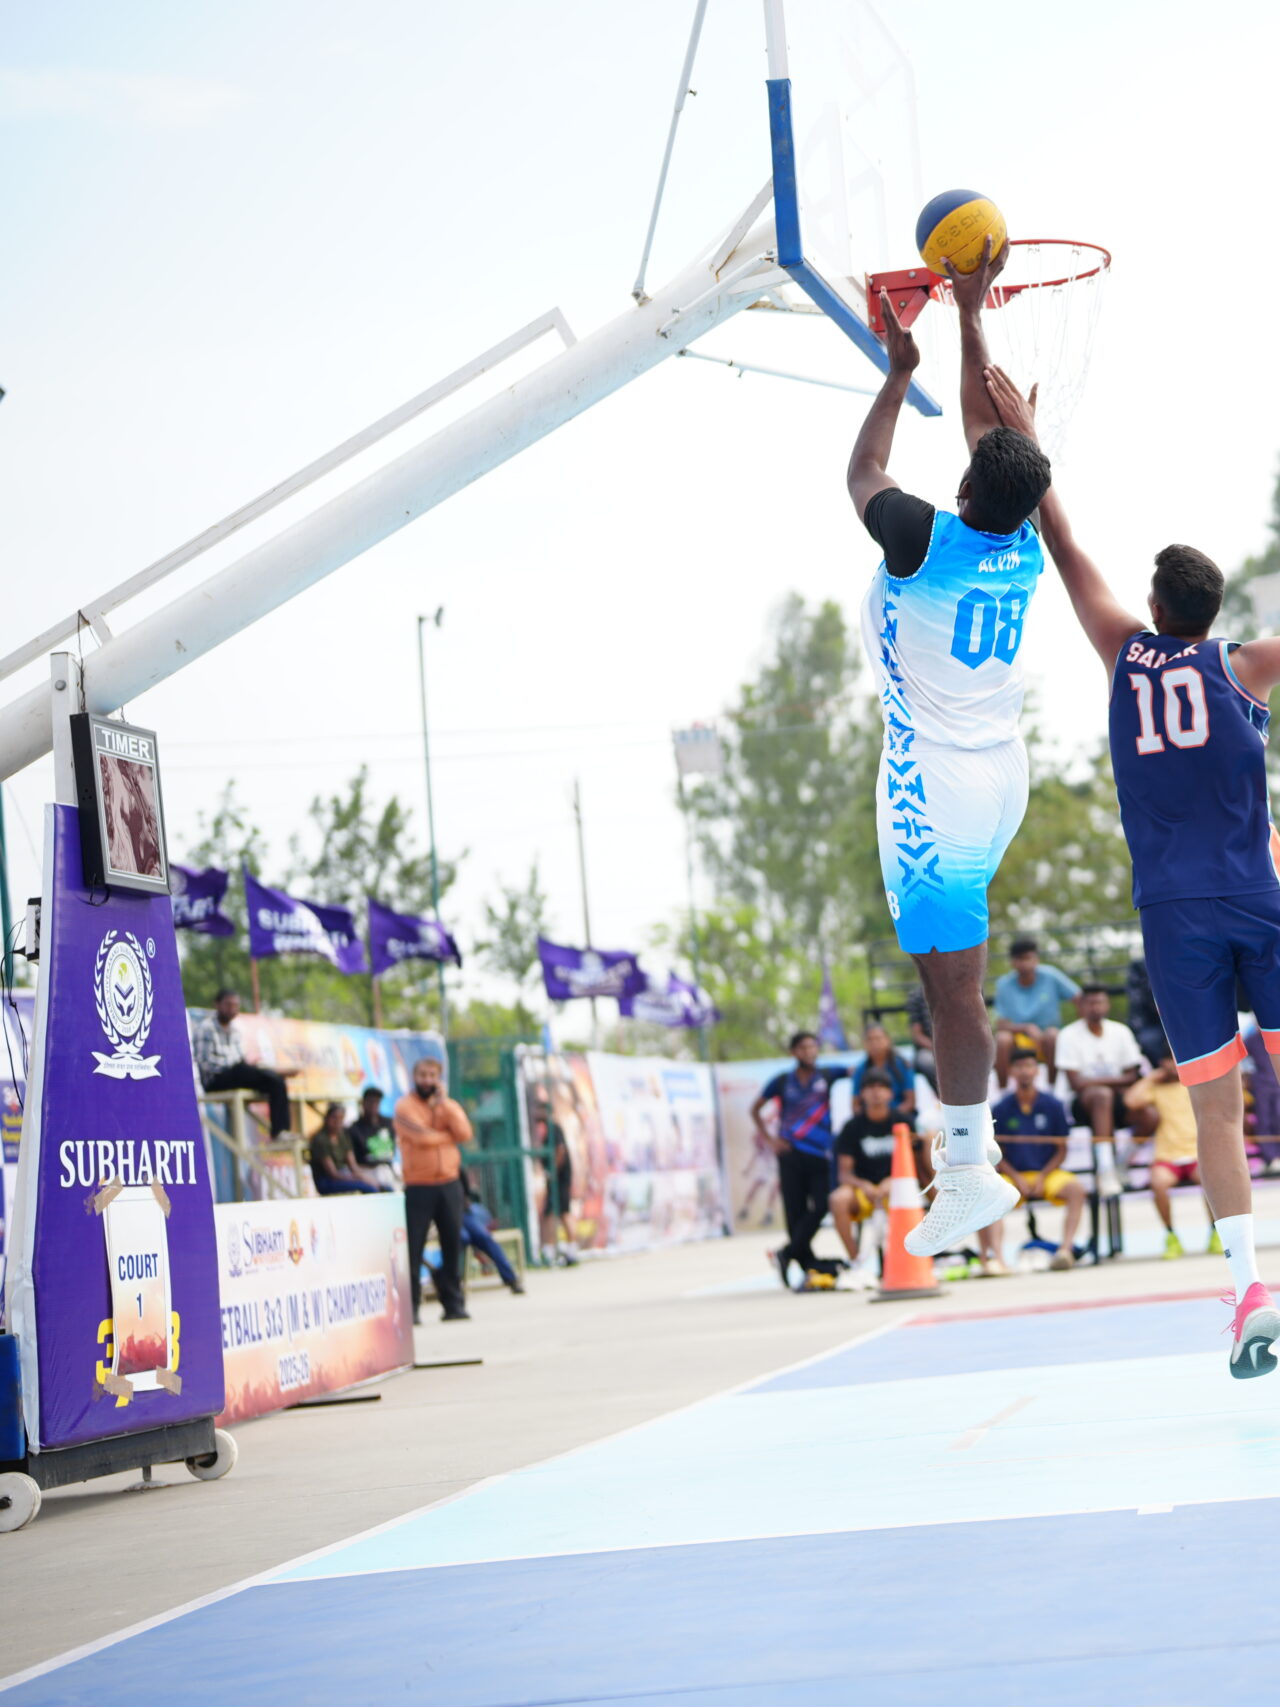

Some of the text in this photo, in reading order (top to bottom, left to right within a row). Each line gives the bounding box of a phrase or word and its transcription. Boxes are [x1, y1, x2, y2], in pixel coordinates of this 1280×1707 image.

[978, 549, 1020, 574] ALVIN
[950, 582, 1029, 670] 08
[1128, 665, 1210, 756] 10
[101, 729, 151, 759] TIMER
[60, 1140, 197, 1188] SUBHARTI
[118, 1253, 158, 1281] COURT
[136, 1292, 143, 1319] 1
[286, 1293, 301, 1343] (M
[303, 1291, 310, 1331] &
[326, 1278, 387, 1324] CHAMPIONSHIP
